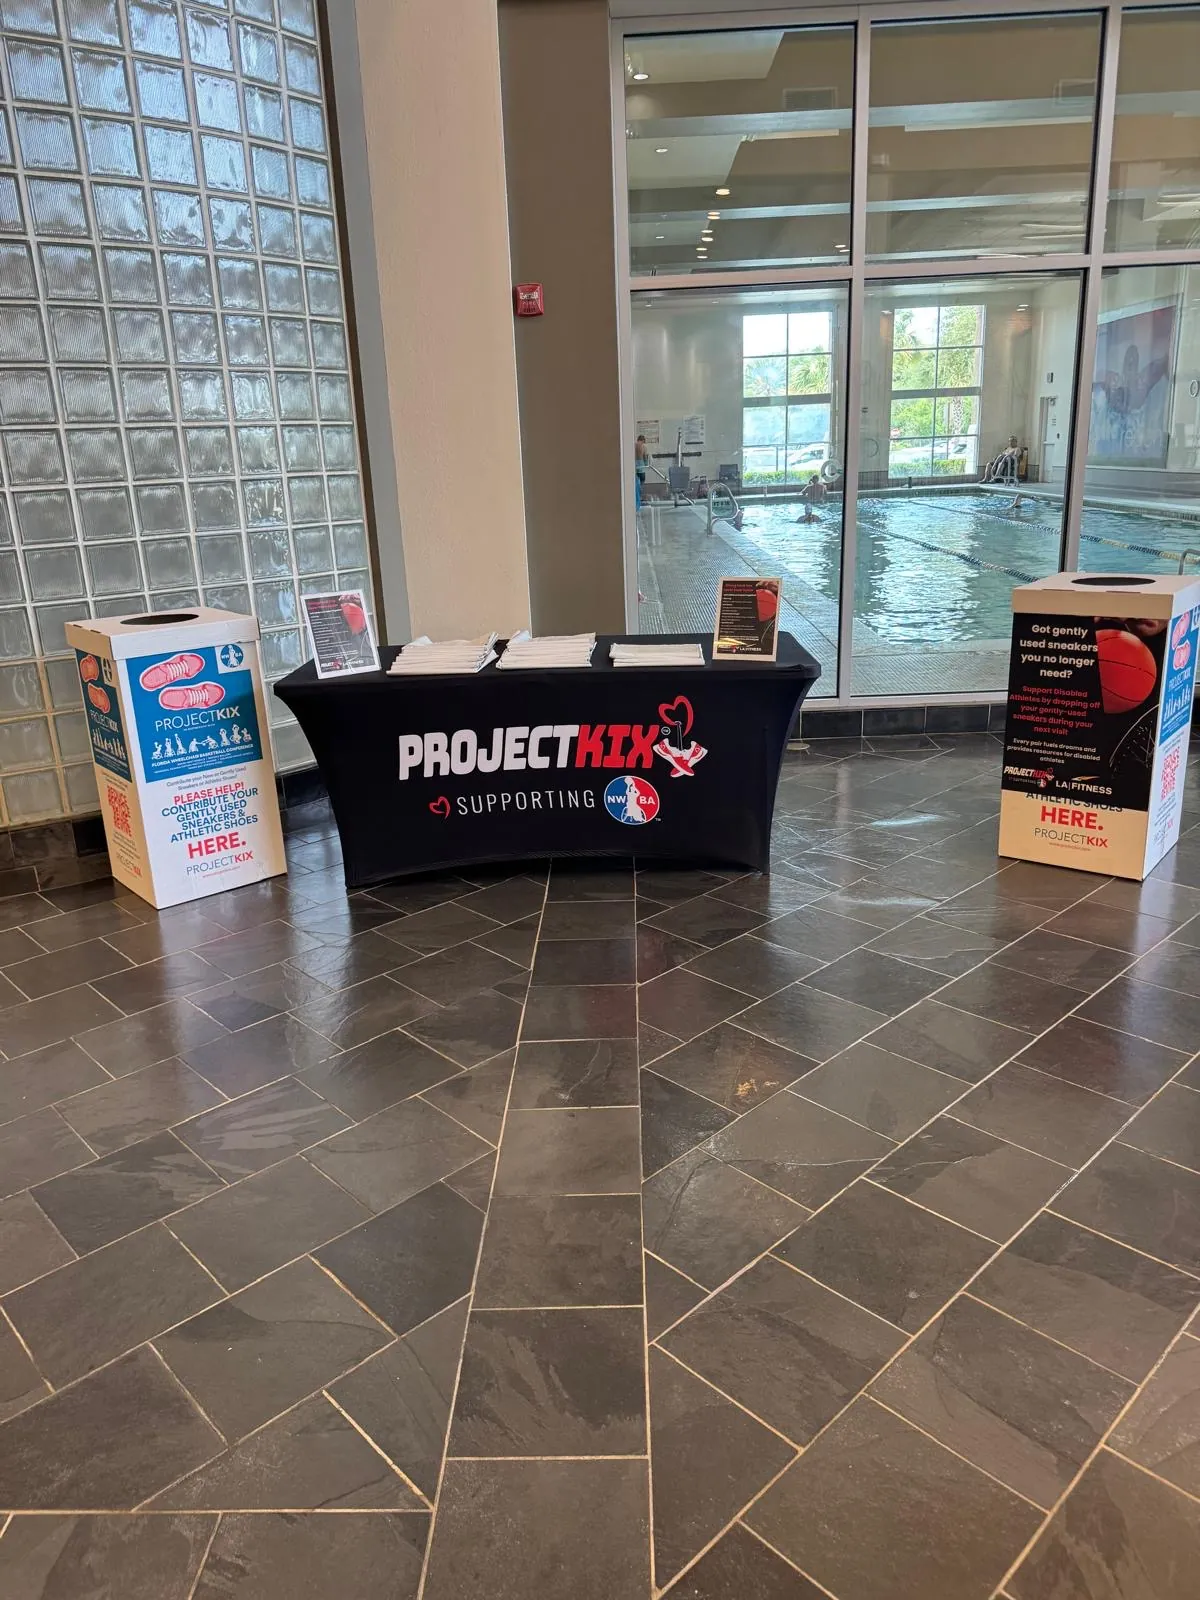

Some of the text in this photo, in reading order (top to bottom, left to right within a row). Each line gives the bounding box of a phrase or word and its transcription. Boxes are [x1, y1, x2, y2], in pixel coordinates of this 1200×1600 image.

[1032, 625, 1088, 638] Got gently
[1020, 640, 1098, 652] used sneakers
[1021, 654, 1041, 663] you
[1059, 655, 1095, 668] longer
[1040, 669, 1072, 678] need?
[1022, 686, 1087, 697] Support Disabled
[1010, 694, 1040, 702] Athletes
[1042, 697, 1051, 705] by
[1053, 699, 1088, 709] dropping
[1039, 706, 1086, 716] gently-used
[155, 706, 240, 732] PROJECTKIX
[1013, 714, 1047, 723] sneakers
[1048, 717, 1073, 727] during
[1052, 728, 1069, 736] visit
[398, 724, 660, 780] PROJECTKIX
[1014, 738, 1029, 746] Every
[1059, 743, 1082, 752] dreams
[1007, 745, 1032, 753] provides
[1034, 748, 1063, 756] resources
[1074, 752, 1100, 761] disabled
[1040, 756, 1064, 764] athletes
[174, 782, 244, 806] PLEASE HELP!
[1071, 782, 1112, 795] FITNESS
[162, 787, 258, 817] CONTRIBUTE YOUR
[457, 790, 595, 815] SUPPORTING
[640, 796, 655, 804] BA
[176, 800, 247, 822] GENTLY USED
[1040, 806, 1103, 831] HERE.
[182, 809, 245, 831] SNEAKERS &
[170, 815, 258, 843] ATHLETIC SHOES
[188, 832, 246, 859] HERE.
[1034, 828, 1108, 848] PROJECTKIX
[186, 851, 253, 876] PROJECTKIX
